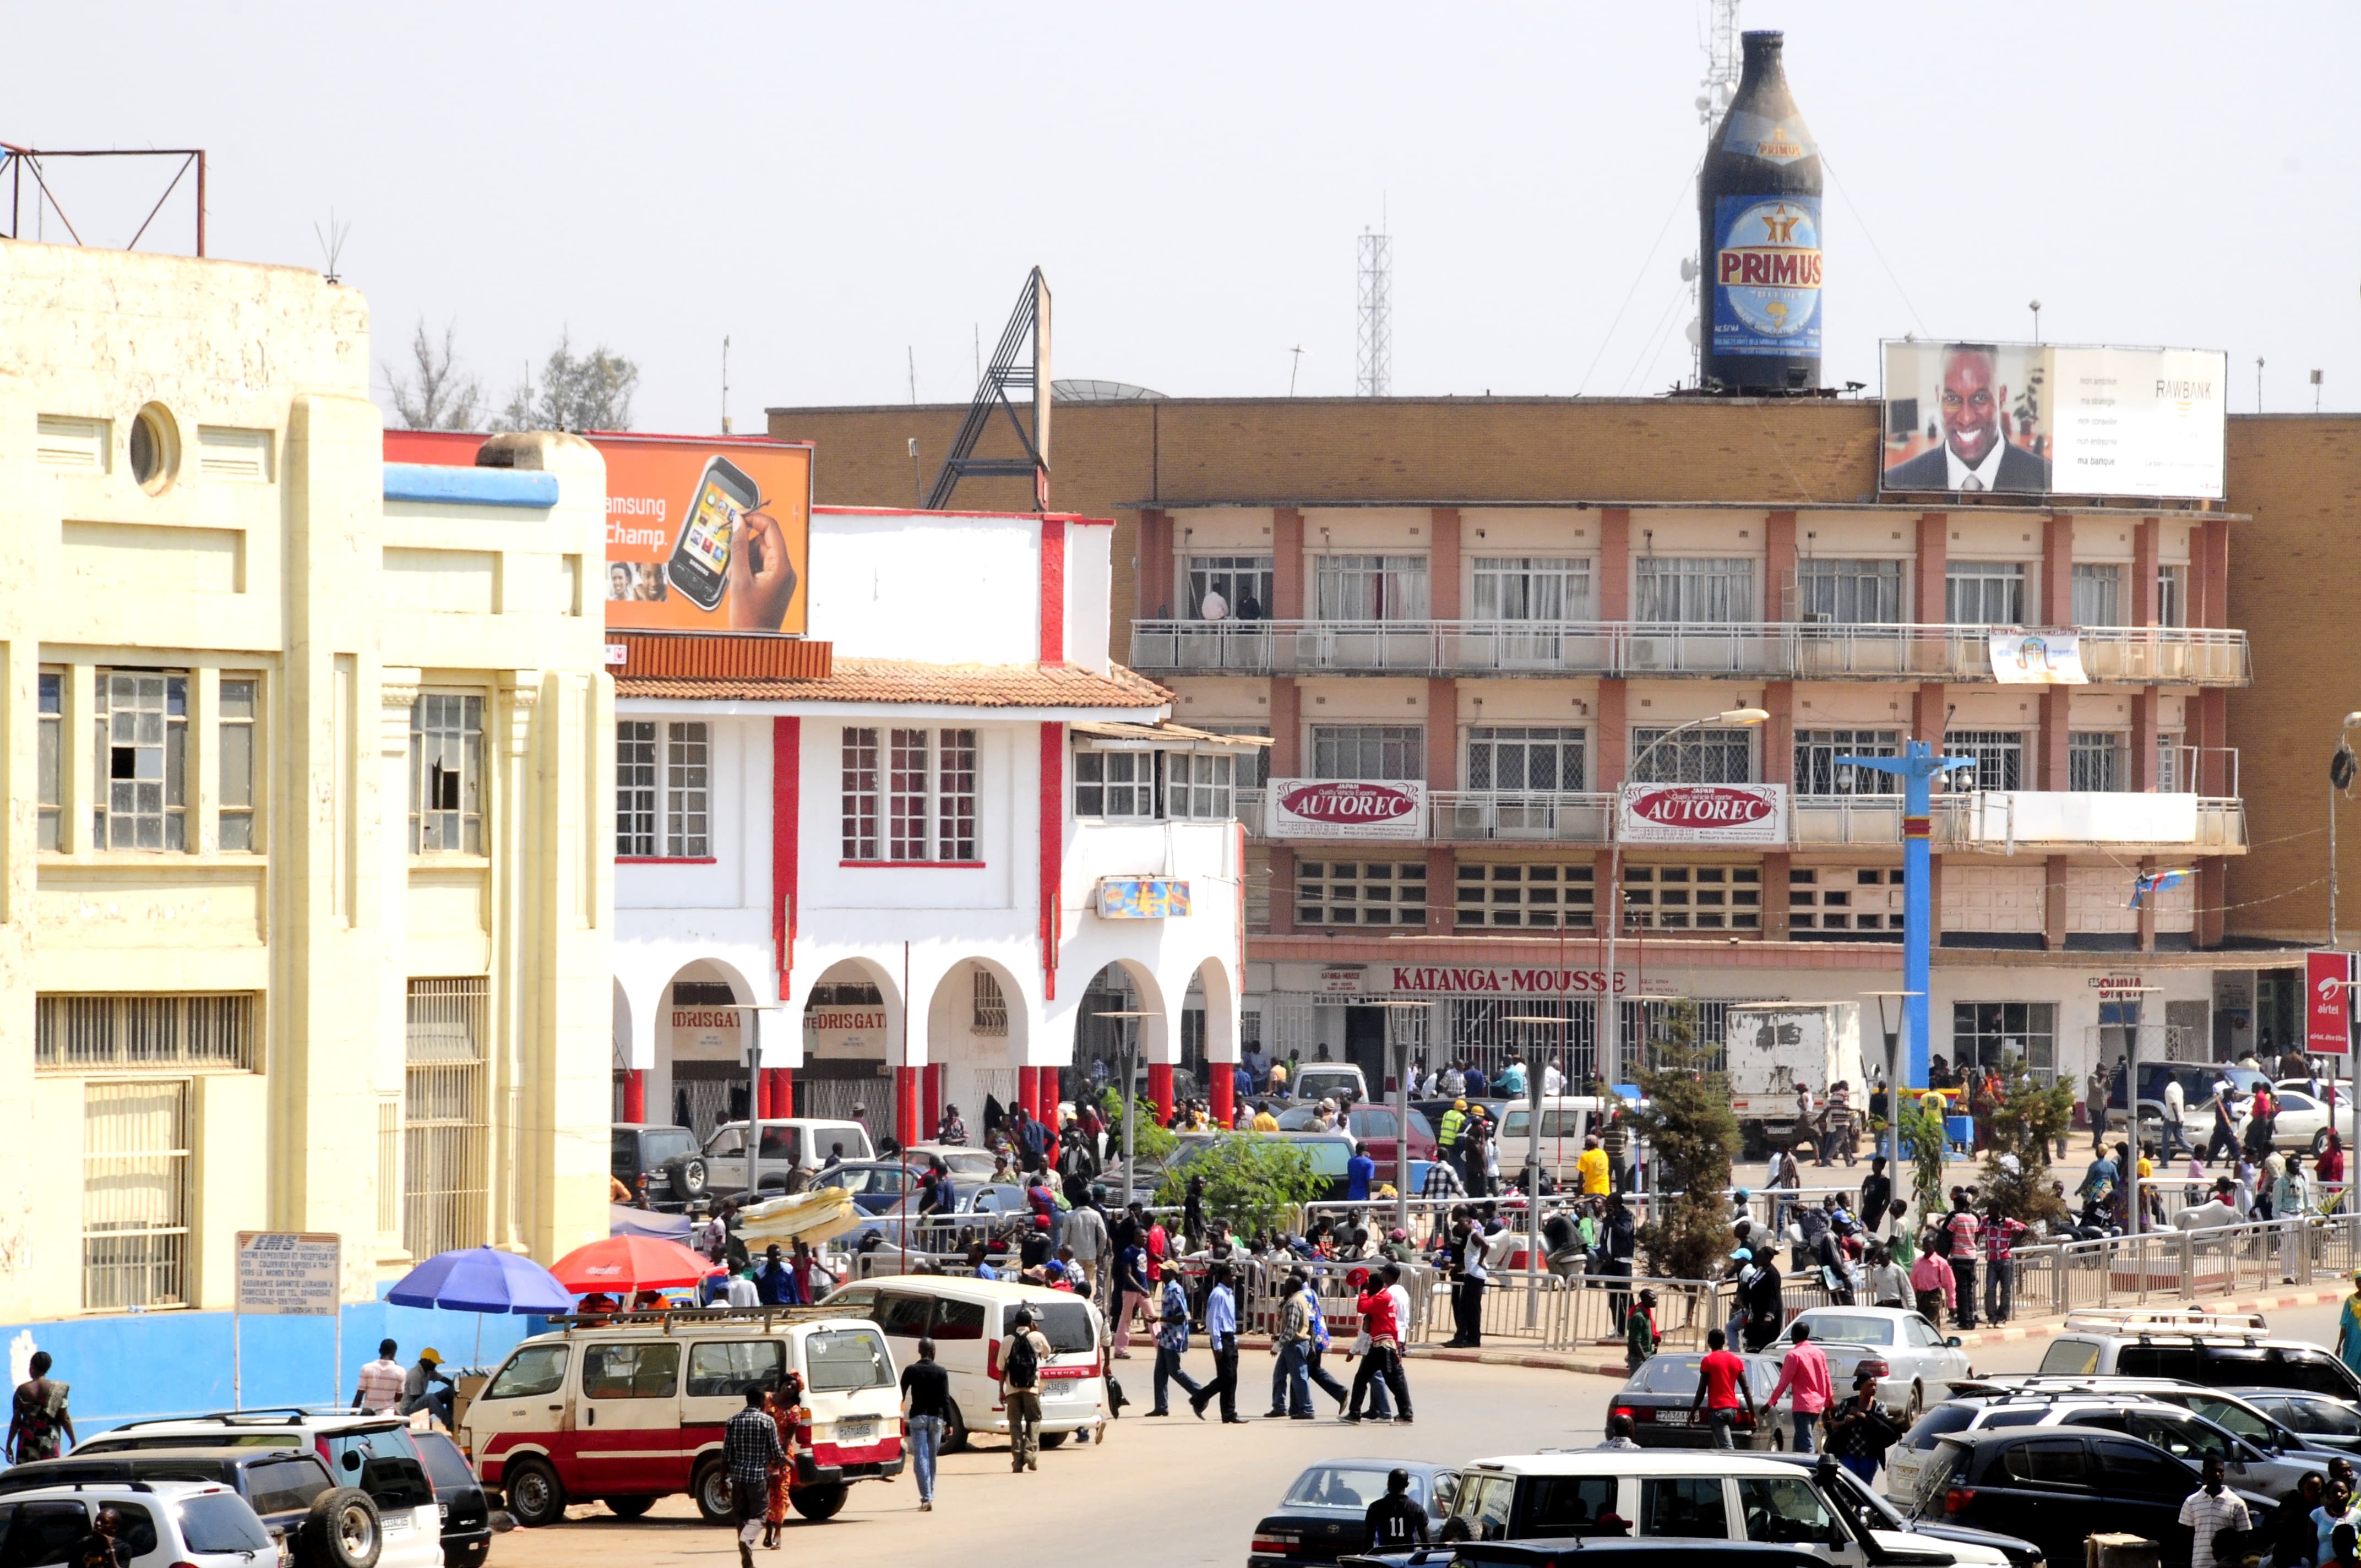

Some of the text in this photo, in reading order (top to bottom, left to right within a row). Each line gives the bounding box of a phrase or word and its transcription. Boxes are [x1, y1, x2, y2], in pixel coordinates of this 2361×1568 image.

[1760, 144, 1802, 155] PRIMUS
[1721, 253, 1821, 285] PRIMUS
[2156, 380, 2211, 400] RAWBANK
[2077, 455, 2115, 467] ma banque
[1293, 795, 1406, 816] AUTOREC
[1646, 799, 1764, 820] AUTOREC
[1392, 967, 1626, 993] KATANGA-MOUSSE
[2318, 1003, 2339, 1015] airtel
[818, 1013, 887, 1029] DRISGAT
[254, 1235, 298, 1250] EMS
[1390, 1517, 1405, 1537] 11
